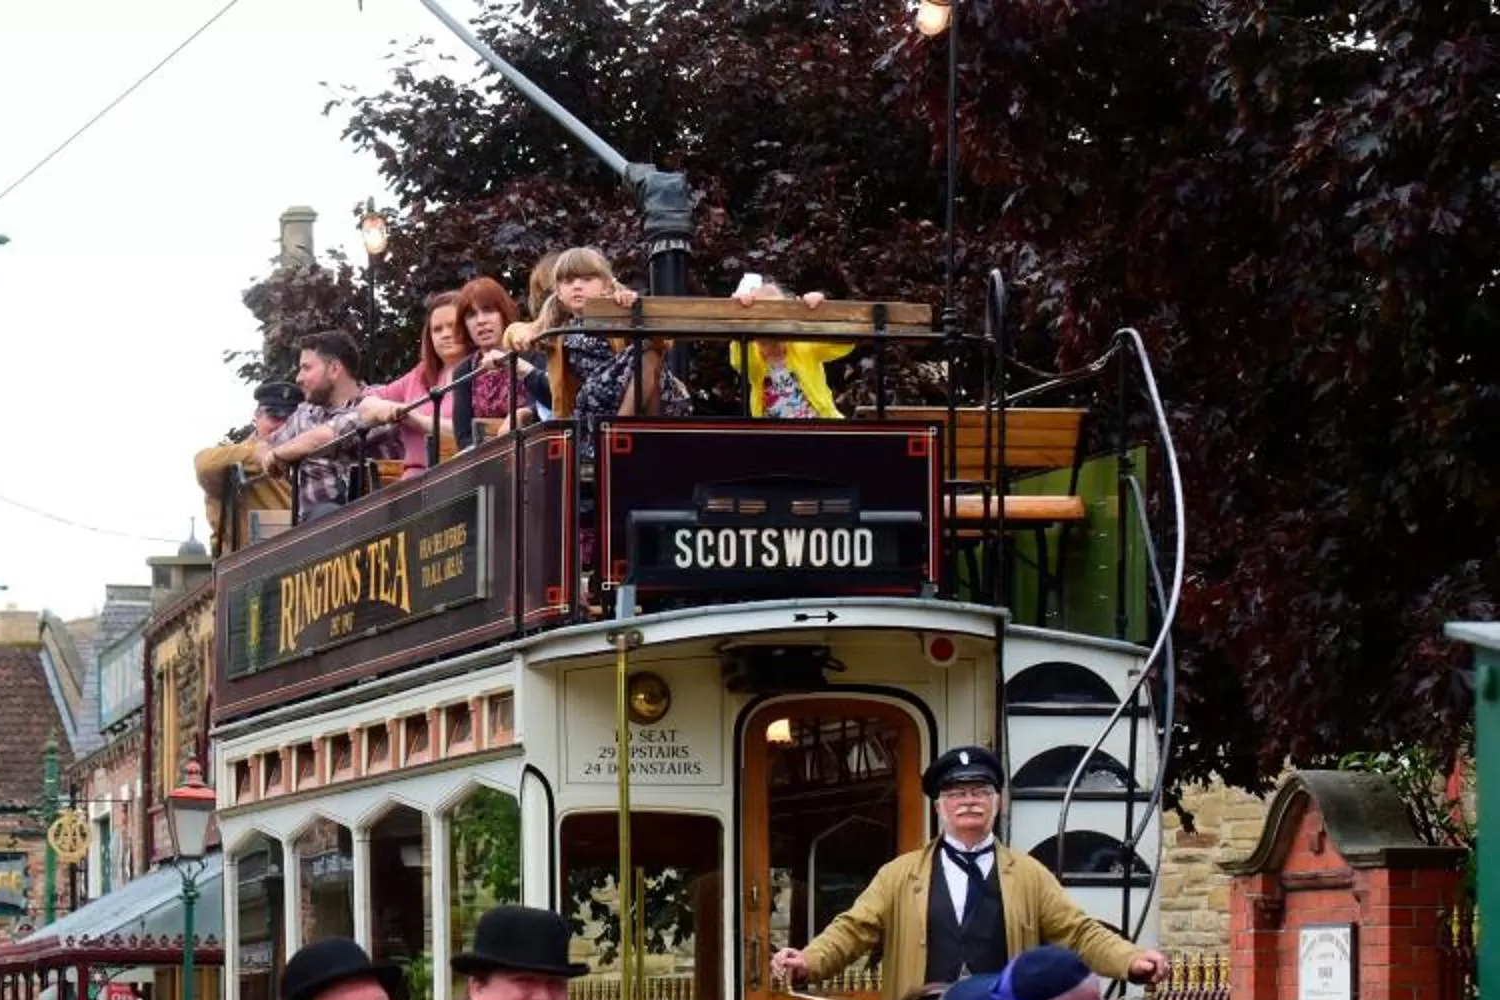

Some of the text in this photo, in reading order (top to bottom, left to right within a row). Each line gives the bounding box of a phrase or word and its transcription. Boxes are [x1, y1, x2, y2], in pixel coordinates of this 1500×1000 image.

[675, 528, 873, 569] SCOTSWOOD
[279, 531, 411, 654] RINGTONS TEA
[639, 729, 677, 742] SEAT
[597, 745, 690, 759] 29 PSTAIRS
[583, 761, 702, 775] 24 DWNSTAIRS
